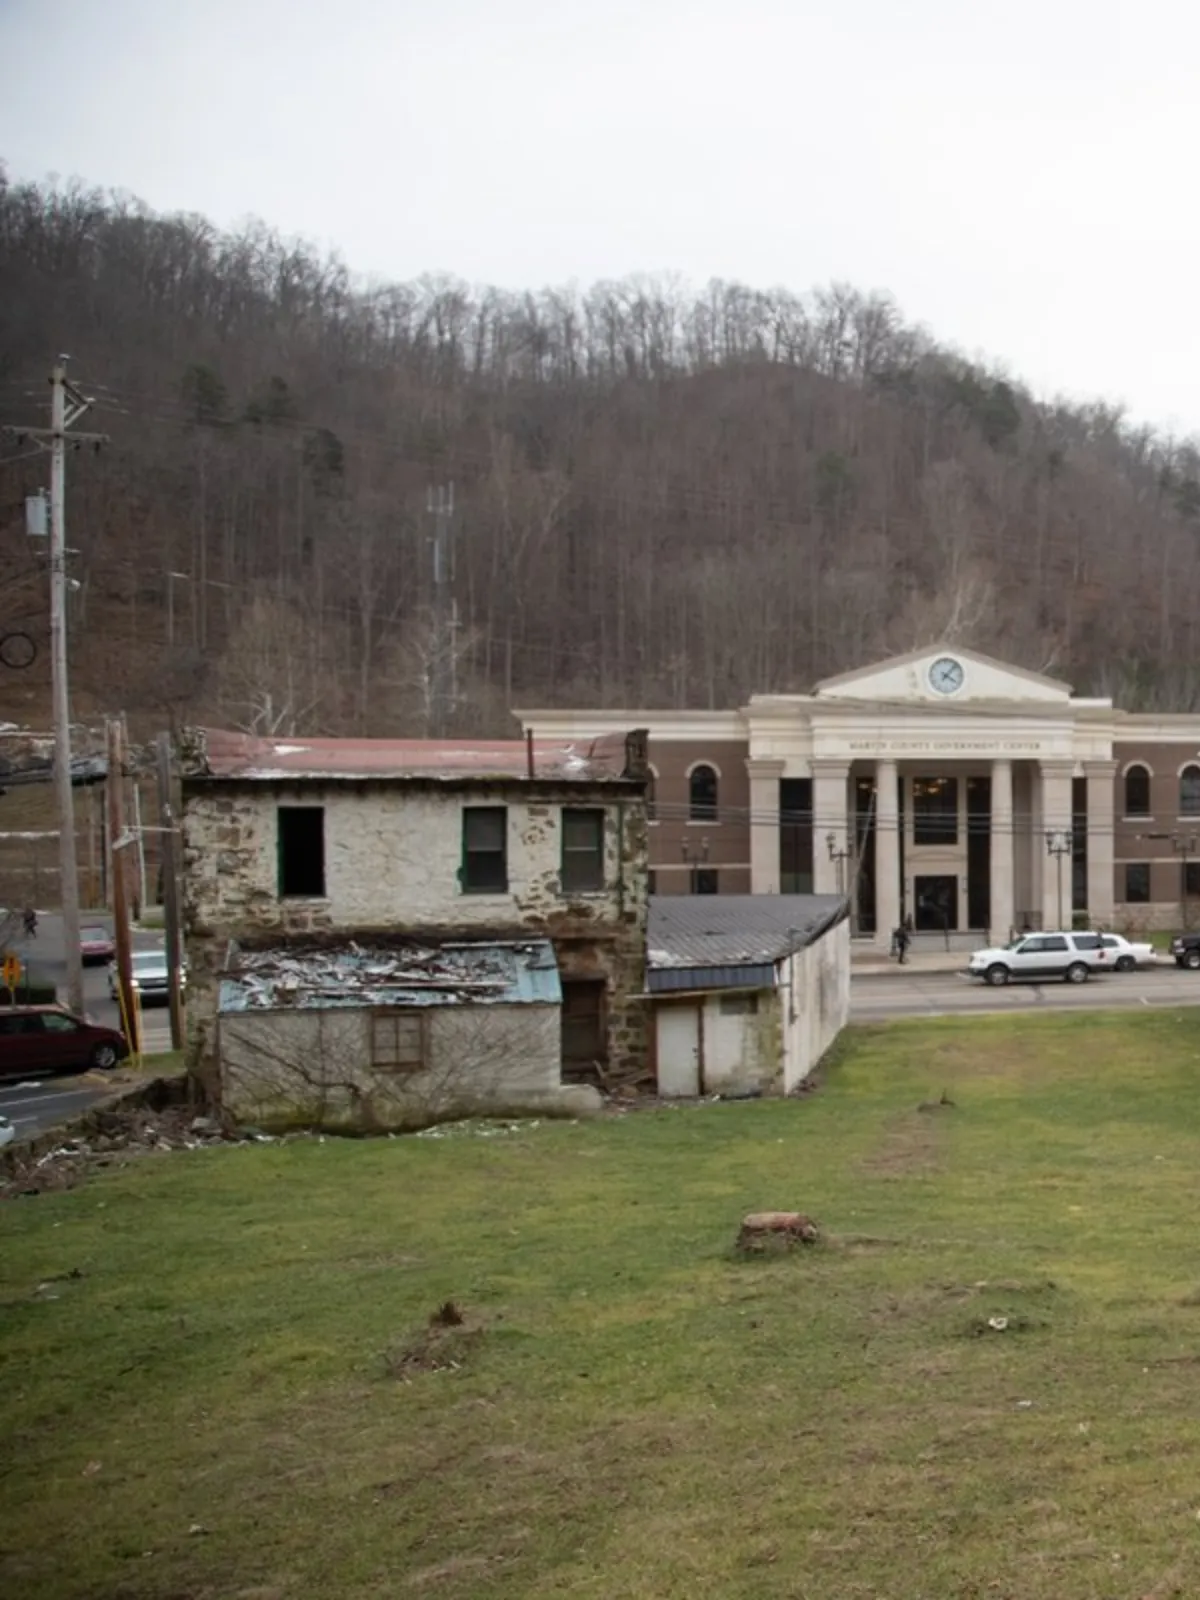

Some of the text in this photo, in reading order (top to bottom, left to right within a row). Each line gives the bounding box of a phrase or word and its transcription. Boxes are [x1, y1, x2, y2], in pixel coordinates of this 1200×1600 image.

[849, 741, 1040, 750] MARTIN COUNTY GOVERNMENT CENTER
